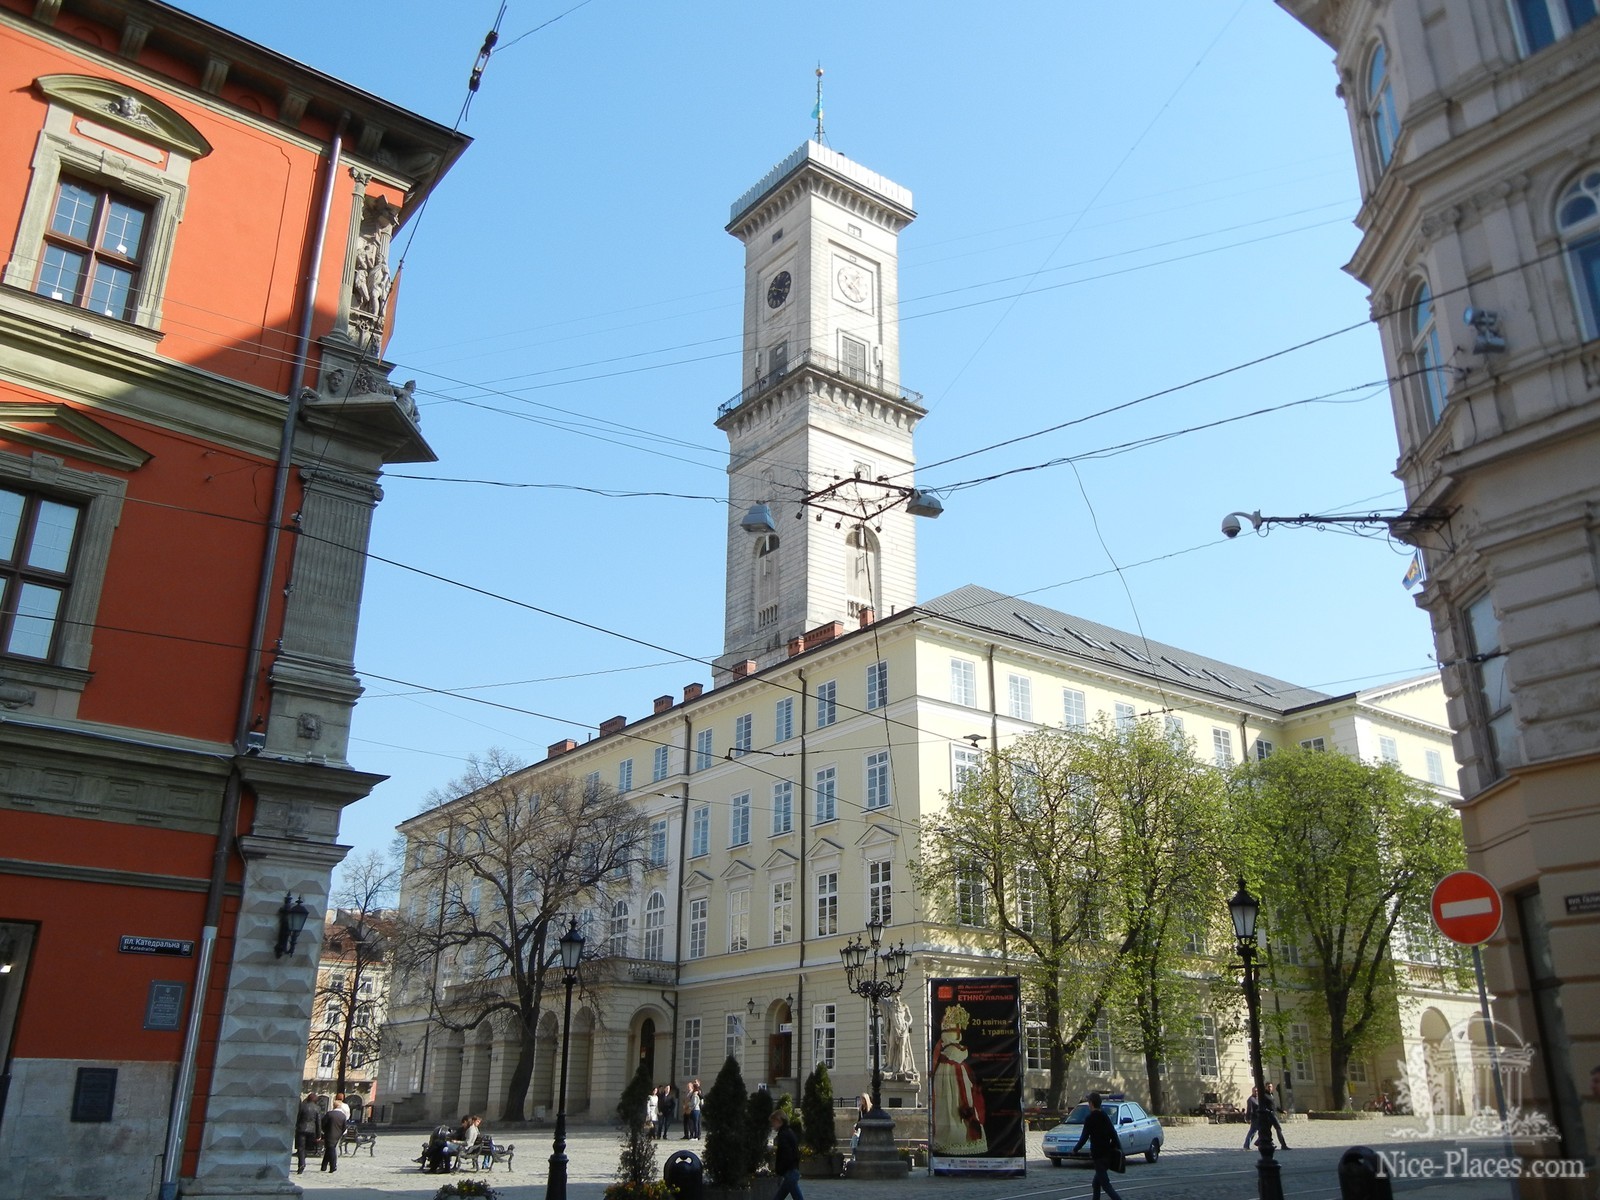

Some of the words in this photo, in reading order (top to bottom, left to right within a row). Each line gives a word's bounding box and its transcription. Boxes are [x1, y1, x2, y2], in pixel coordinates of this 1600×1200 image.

[135, 938, 180, 949] Катедральна
[971, 1018, 981, 1026] 20
[982, 1018, 1007, 1026] квітня
[981, 1028, 986, 1036] 1
[988, 1029, 1014, 1037] травня
